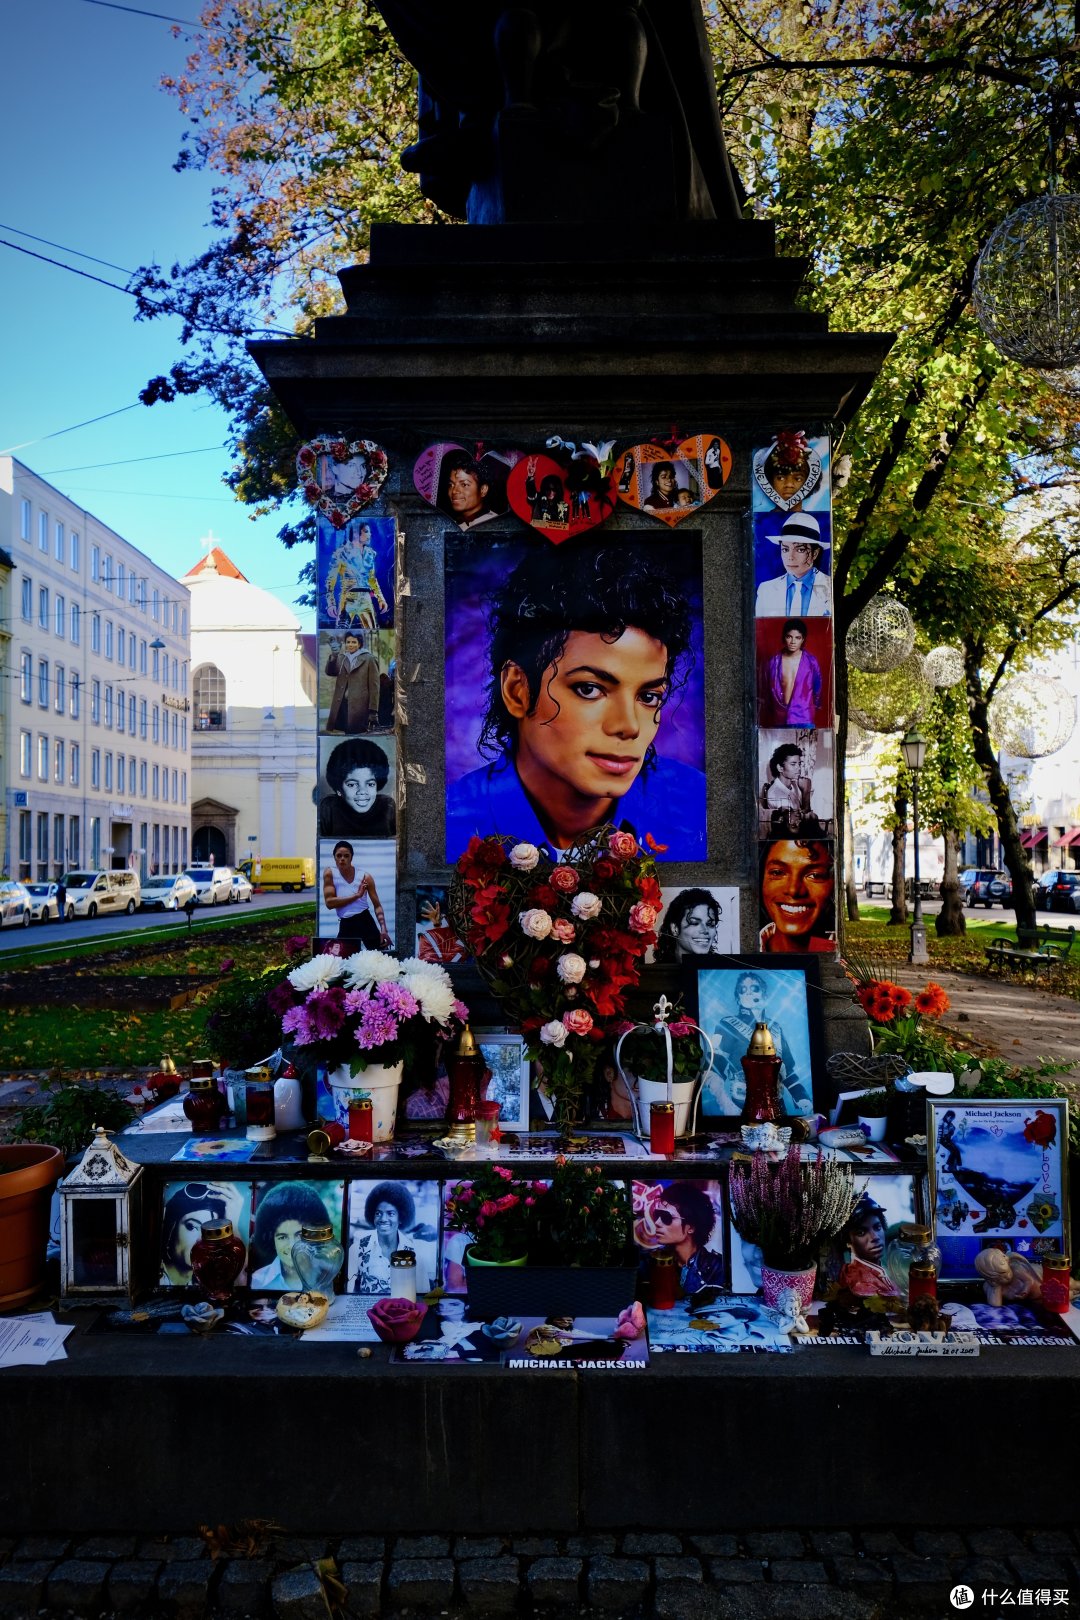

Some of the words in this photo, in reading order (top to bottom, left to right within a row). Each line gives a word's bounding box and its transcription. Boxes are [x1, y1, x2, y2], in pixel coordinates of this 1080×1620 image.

[761, 482, 781, 504] LOVE
[785, 494, 801, 509] YOU
[993, 1110, 1022, 1118] Jackson
[796, 1336, 862, 1345] MICHAEL
[1008, 1336, 1077, 1346] JACKSON
[881, 1346, 912, 1355] Michael
[915, 1345, 938, 1357] Jackson
[509, 1359, 575, 1369] MICHAEL
[577, 1359, 646, 1369] JACKSON
